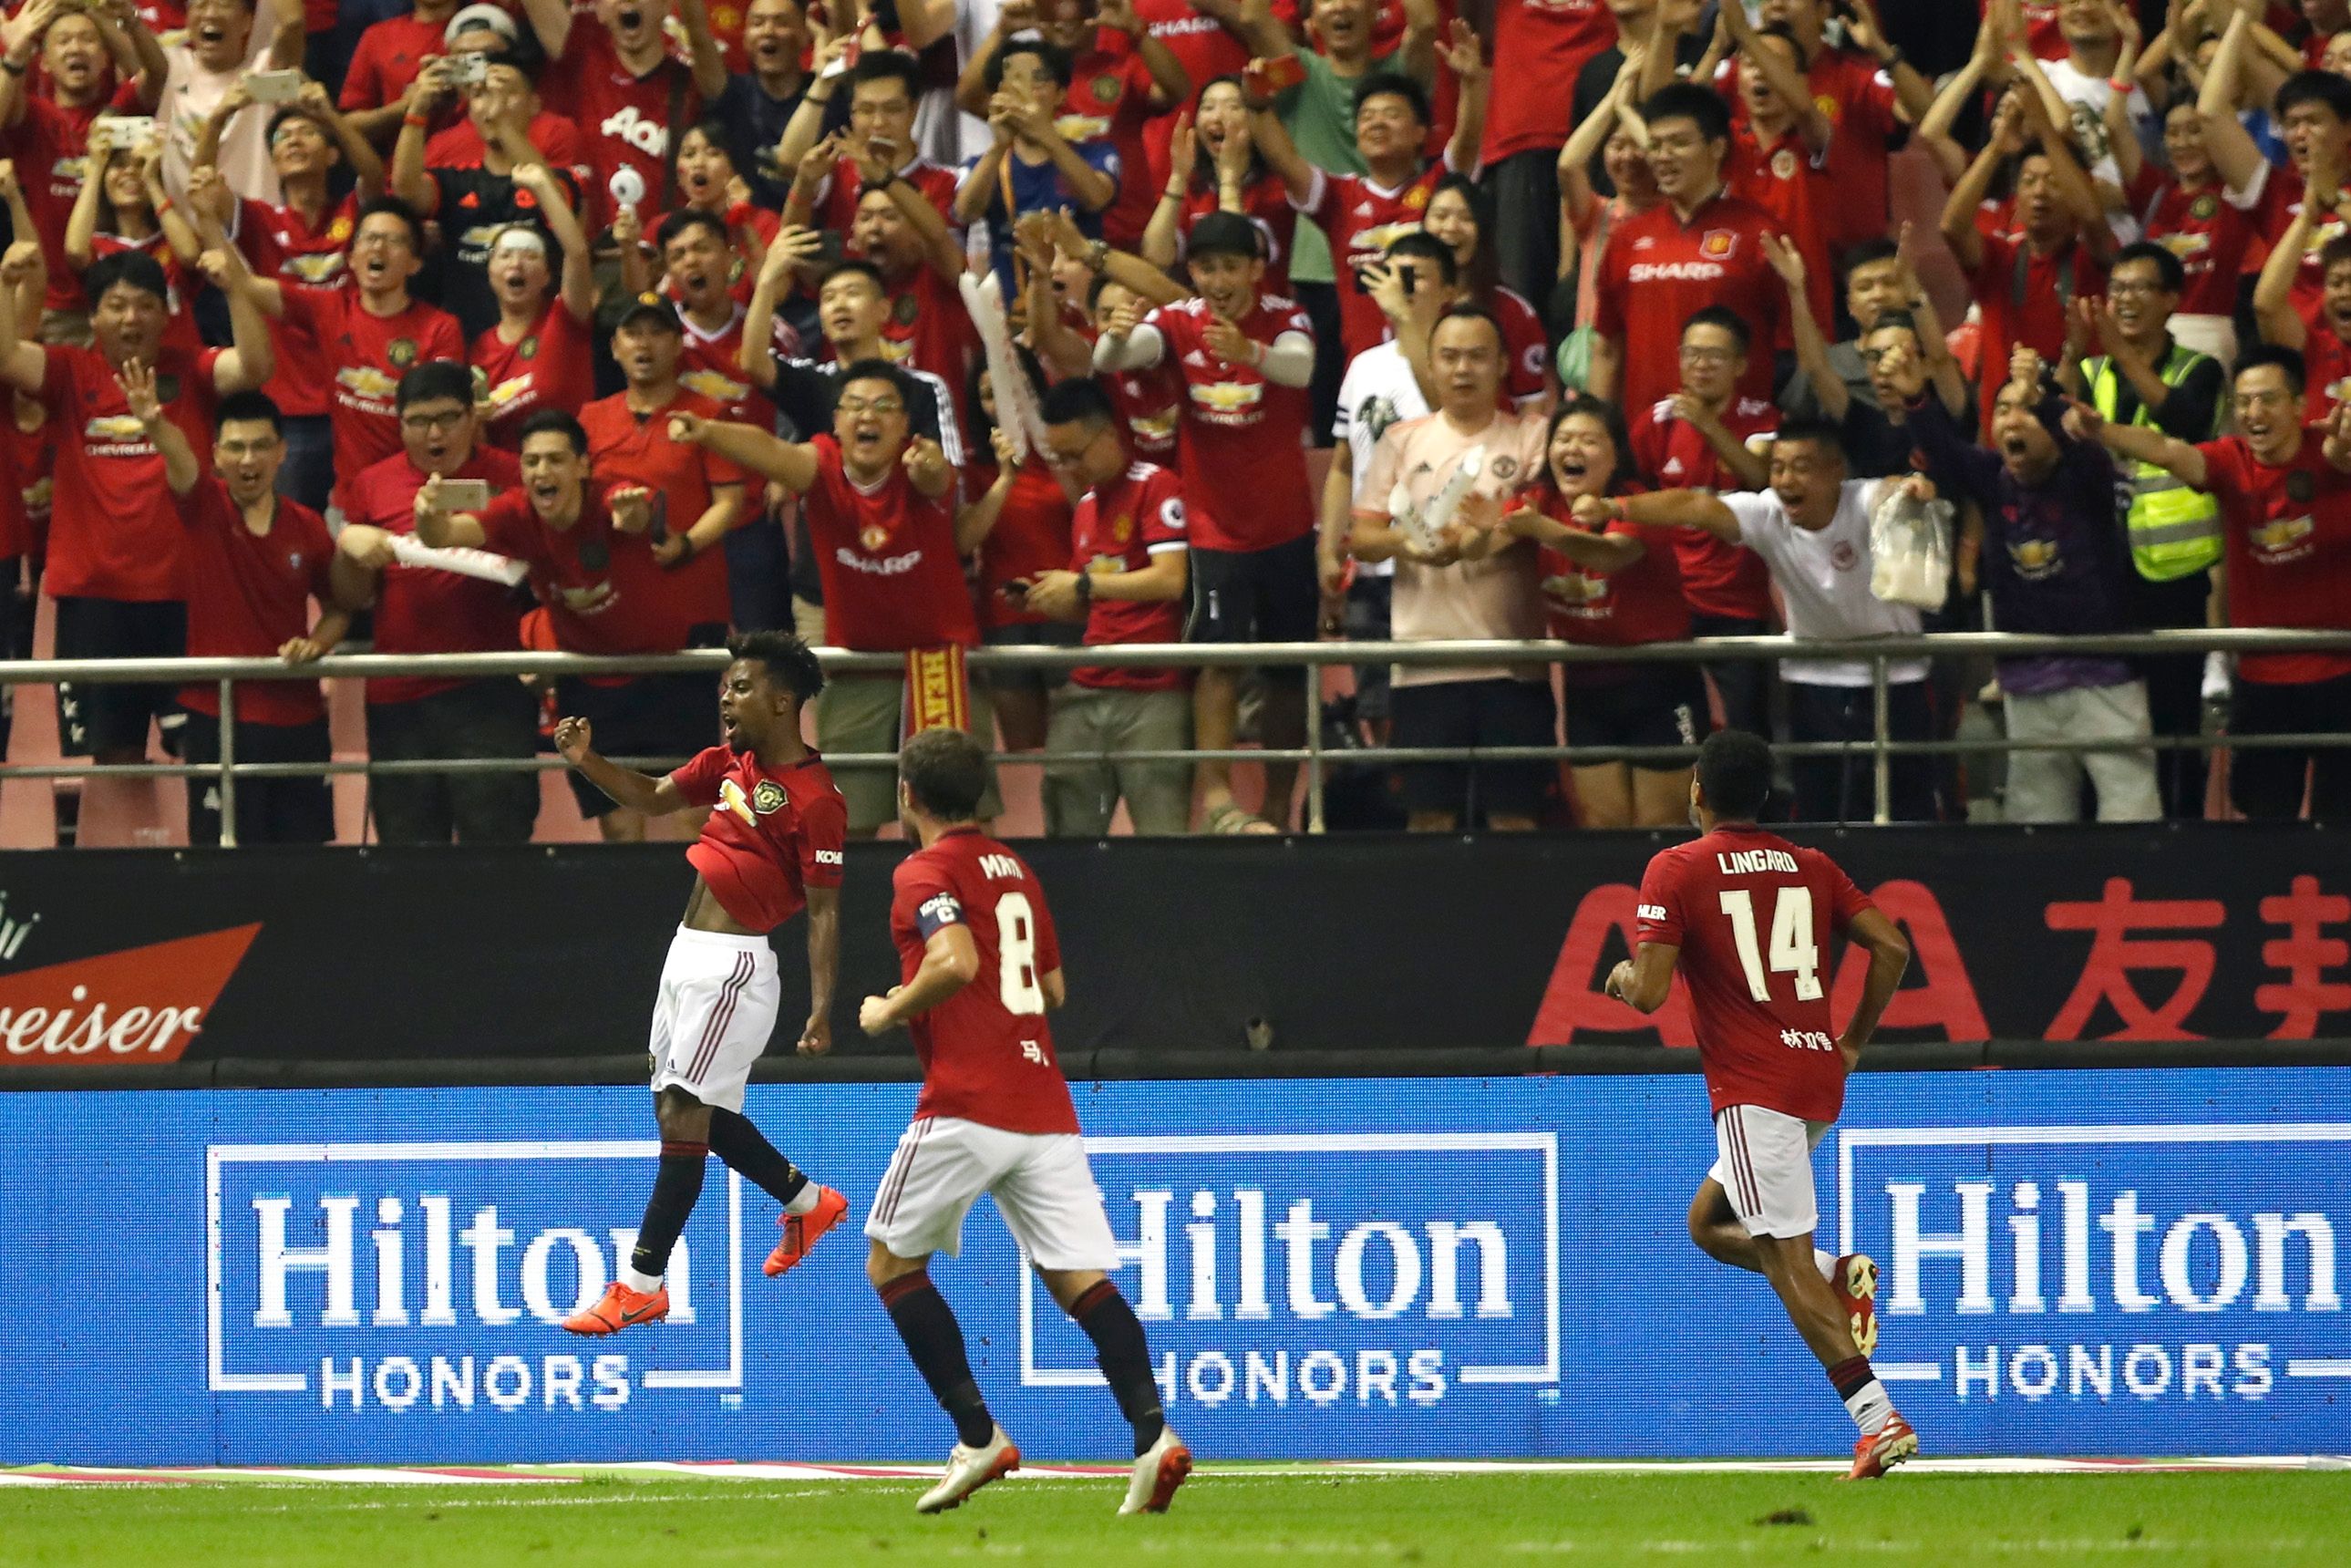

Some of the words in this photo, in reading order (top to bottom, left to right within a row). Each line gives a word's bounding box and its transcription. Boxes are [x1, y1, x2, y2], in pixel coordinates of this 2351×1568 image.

[1628, 261, 1725, 283] SHARP
[836, 547, 923, 576] SHARP
[815, 850, 843, 865] KOH
[1717, 849, 1799, 875] LINGARD
[936, 905, 956, 923] C
[994, 891, 1045, 1016] 8
[1526, 880, 1992, 1047] AA
[1718, 886, 1824, 1003] 14
[1885, 1175, 2343, 1314] Hilton
[320, 1354, 631, 1412] HONORS
[1954, 1342, 2274, 1403] HONORS
